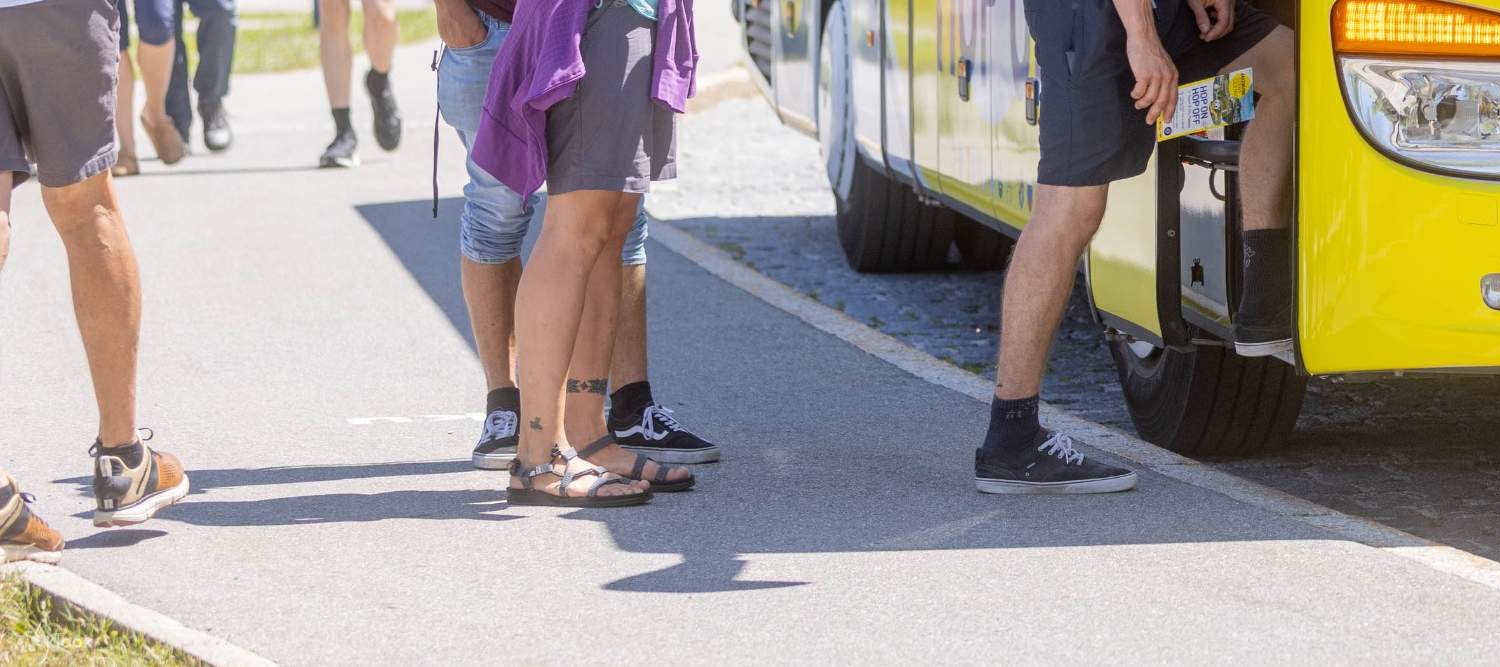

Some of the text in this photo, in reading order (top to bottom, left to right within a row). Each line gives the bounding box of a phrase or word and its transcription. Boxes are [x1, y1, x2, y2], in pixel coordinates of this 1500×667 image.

[1192, 87, 1201, 125] HOP OFF
[1200, 85, 1209, 120] HOP ON
